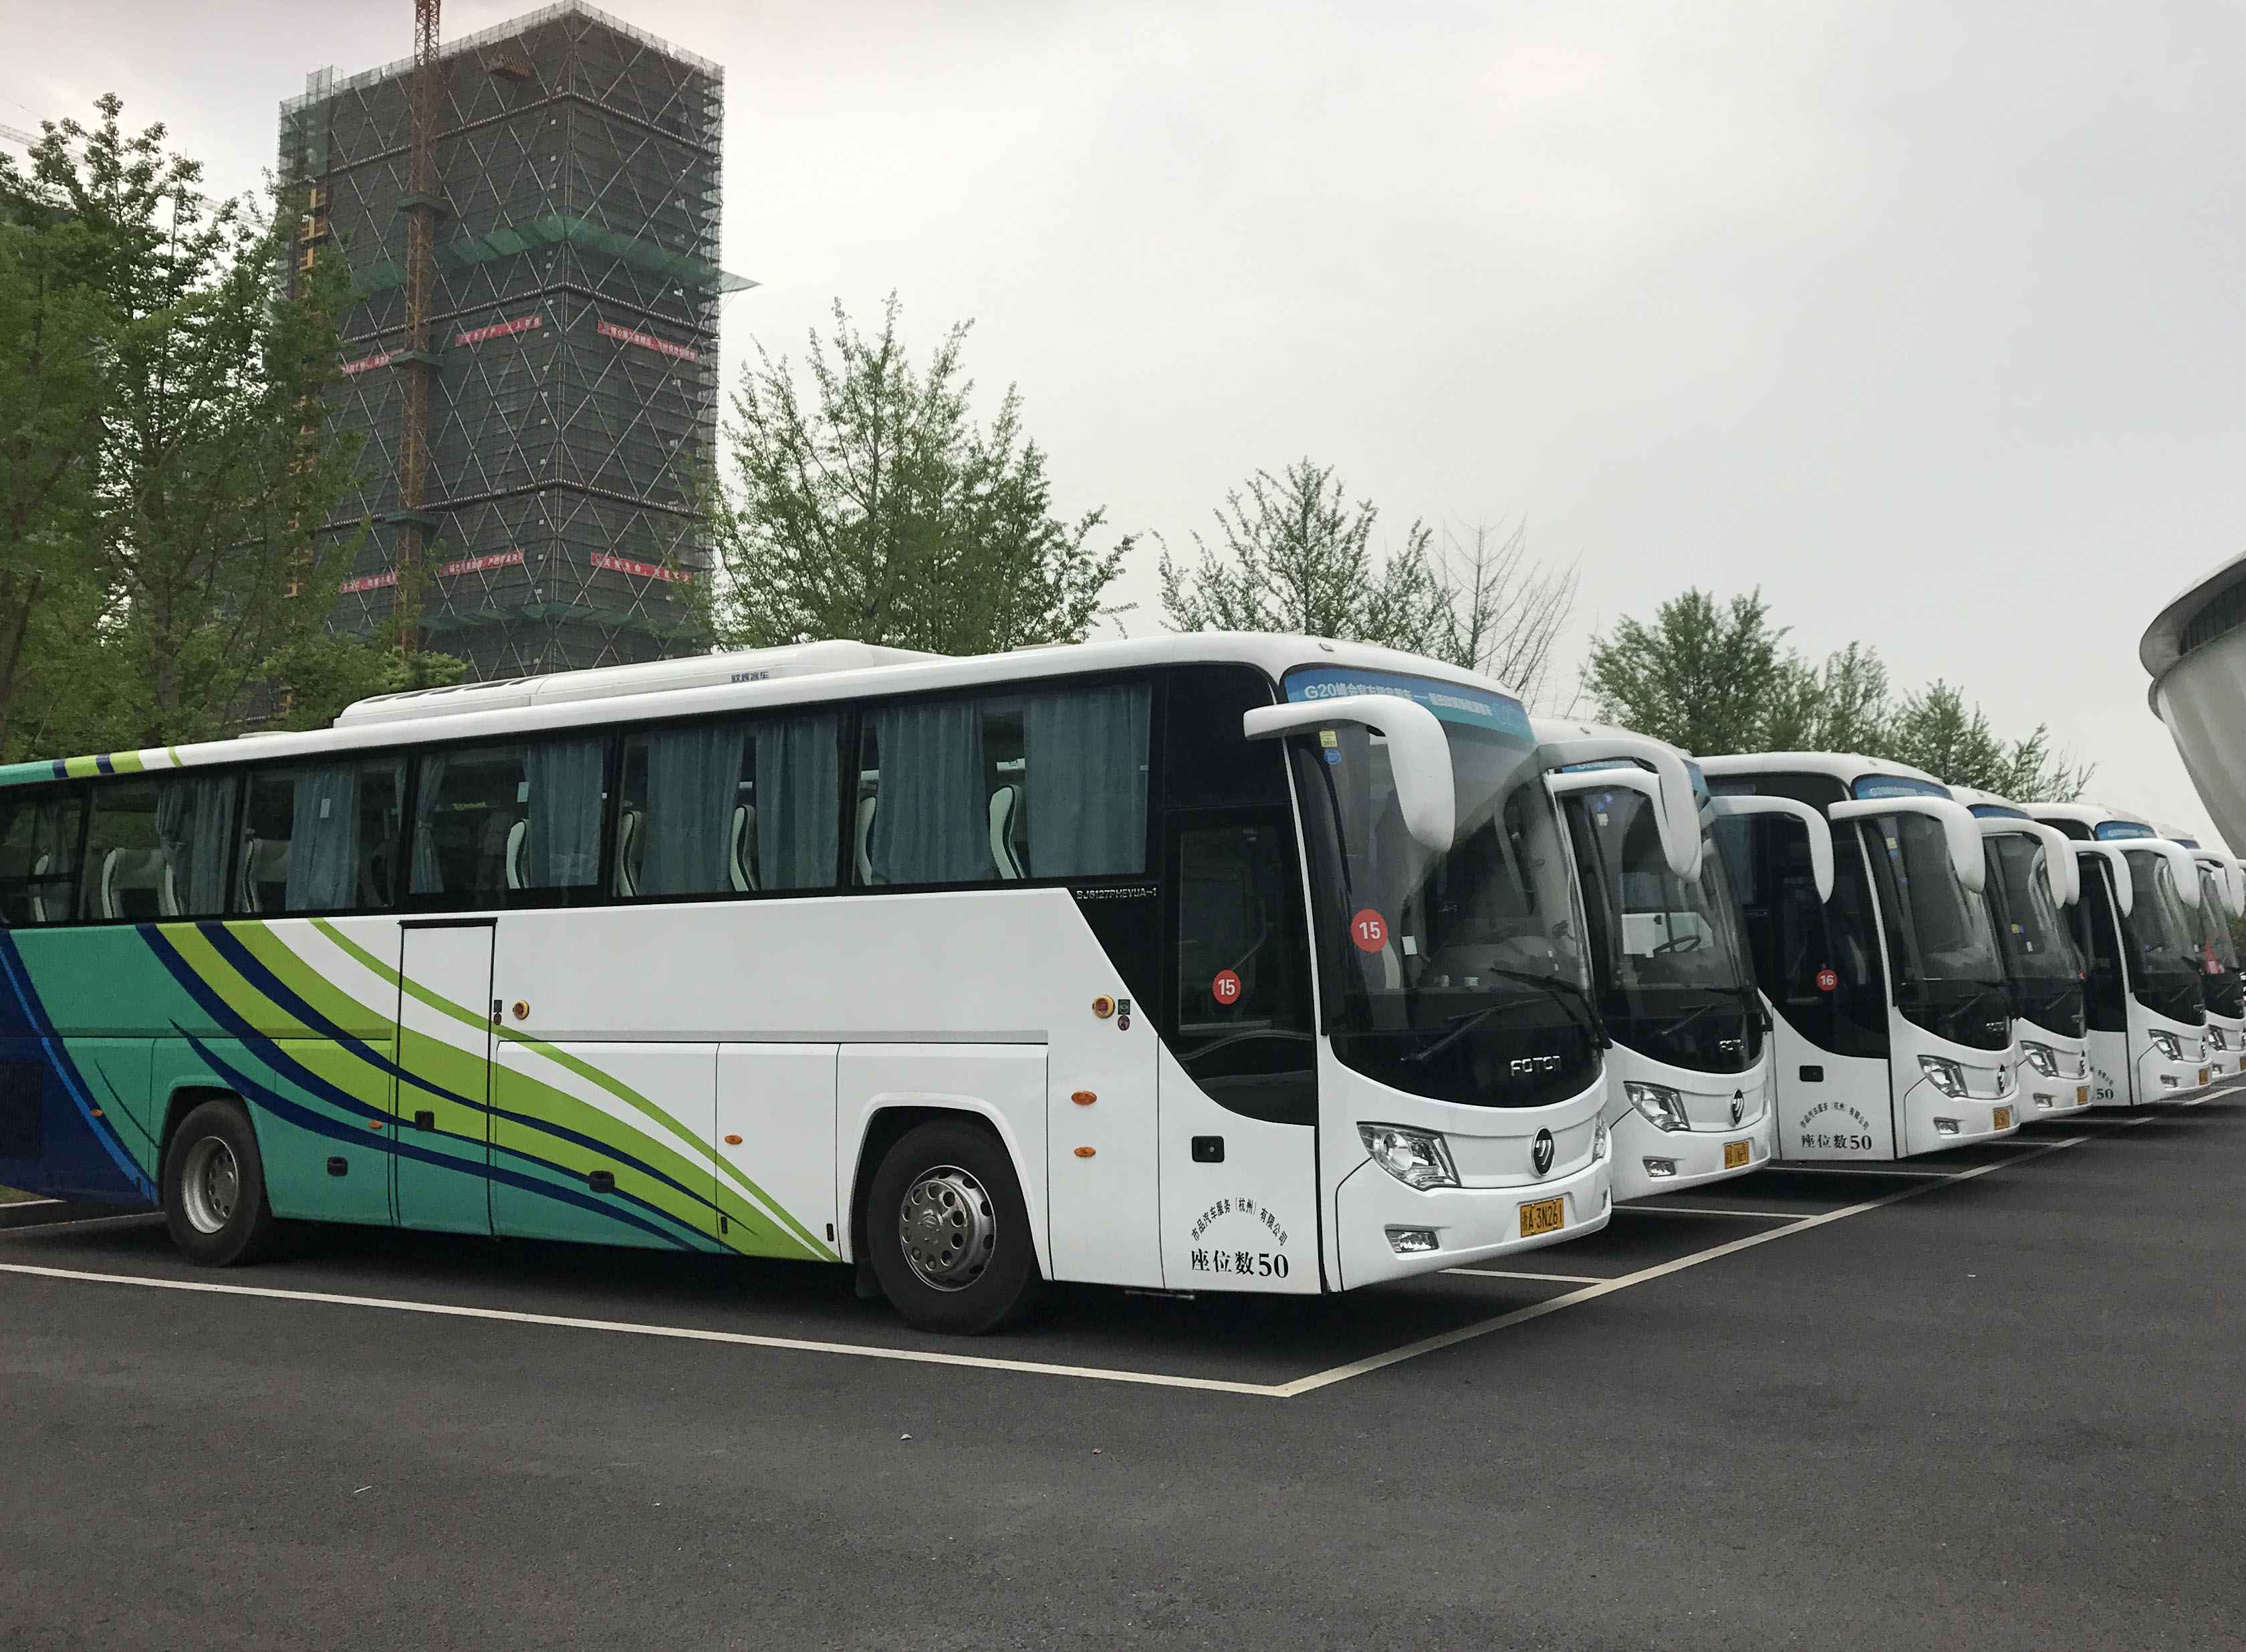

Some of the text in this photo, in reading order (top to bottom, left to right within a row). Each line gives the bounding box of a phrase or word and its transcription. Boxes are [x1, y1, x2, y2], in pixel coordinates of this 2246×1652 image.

[1359, 921, 1381, 940] 15
[1218, 978, 1235, 996] 15
[1820, 974, 1834, 986] 16
[1191, 1248, 1289, 1278] 座位数50
